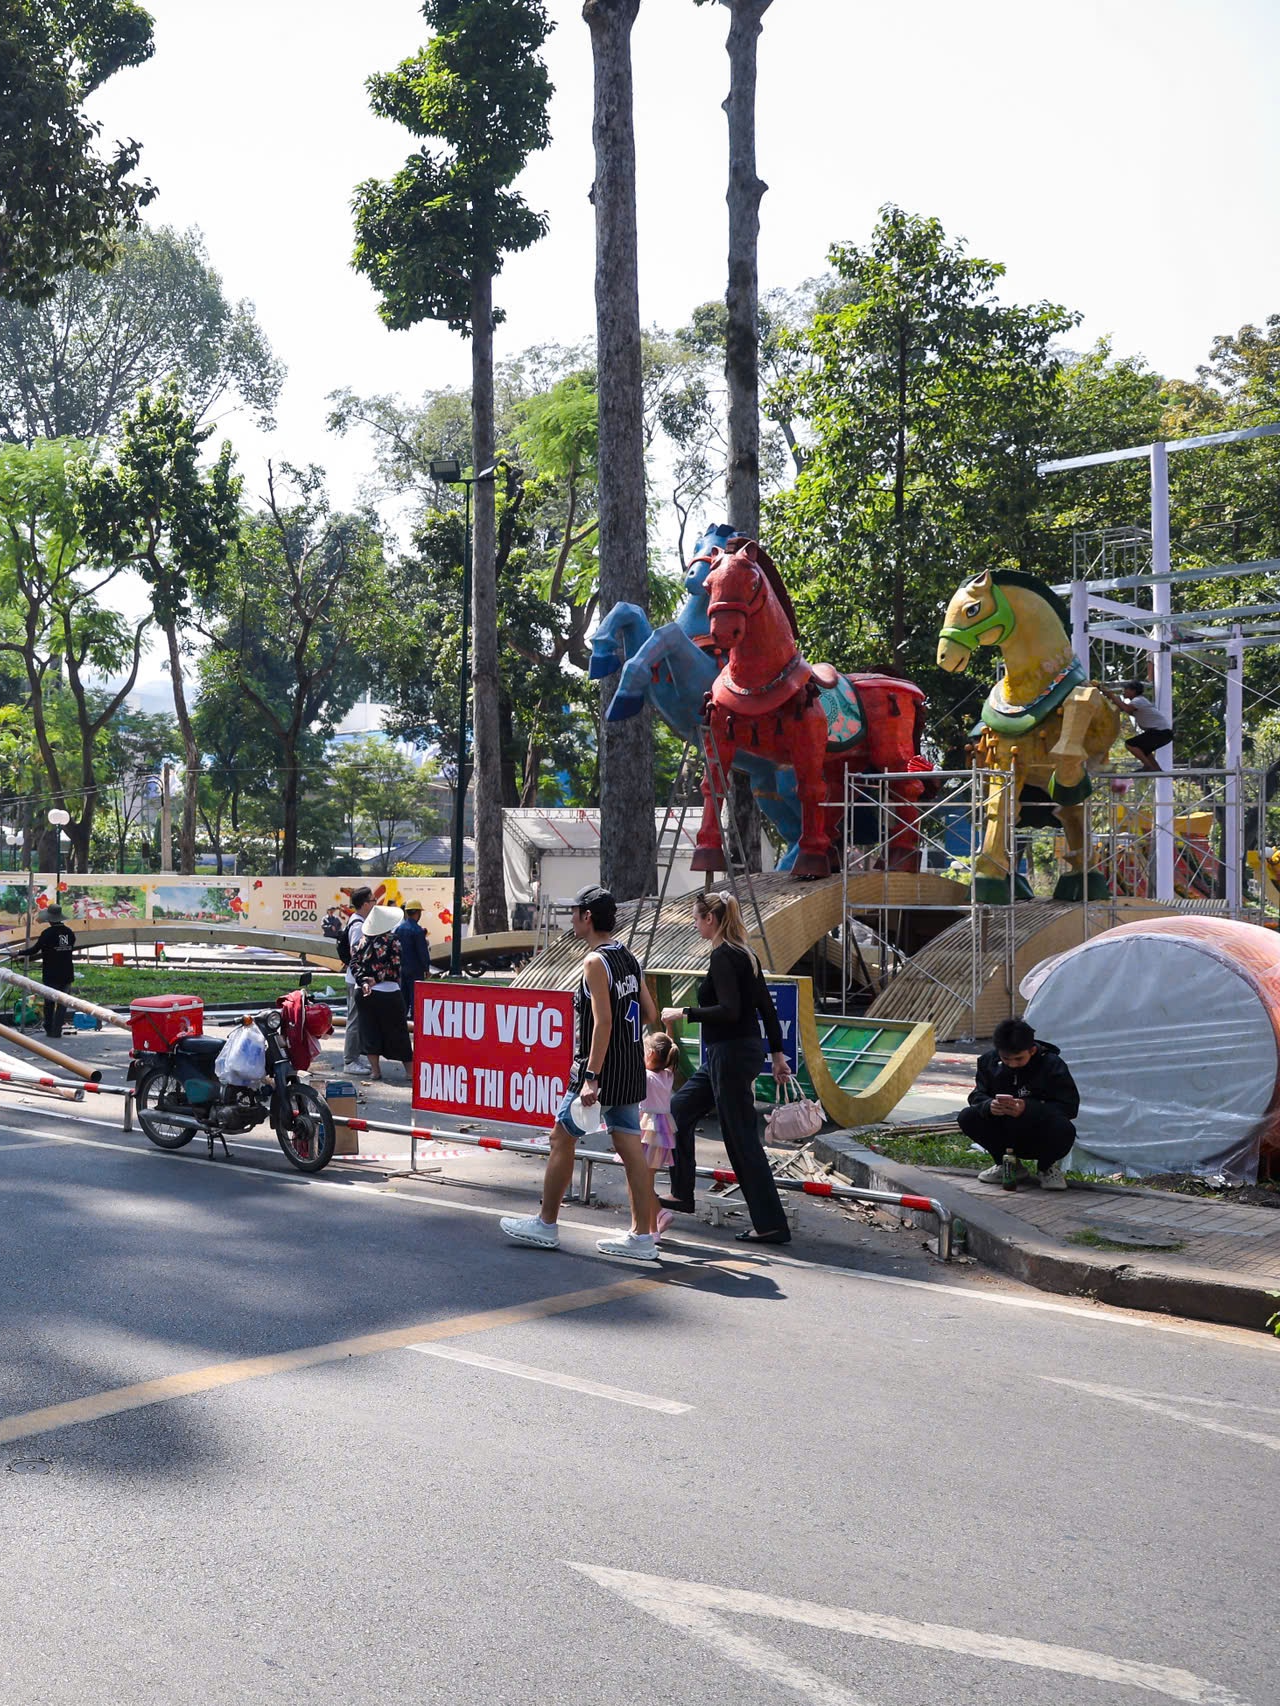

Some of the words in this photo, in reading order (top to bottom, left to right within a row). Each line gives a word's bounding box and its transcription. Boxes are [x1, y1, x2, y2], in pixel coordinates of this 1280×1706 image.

[282, 910, 318, 921] 2026
[283, 900, 317, 909] TP.HCM
[423, 998, 485, 1041] KHU
[495, 1002, 563, 1053] VỰC
[624, 1000, 640, 1042] 1
[420, 1062, 468, 1104] ĐANG
[473, 1067, 504, 1109] THI
[509, 1067, 565, 1117] CÔNG
